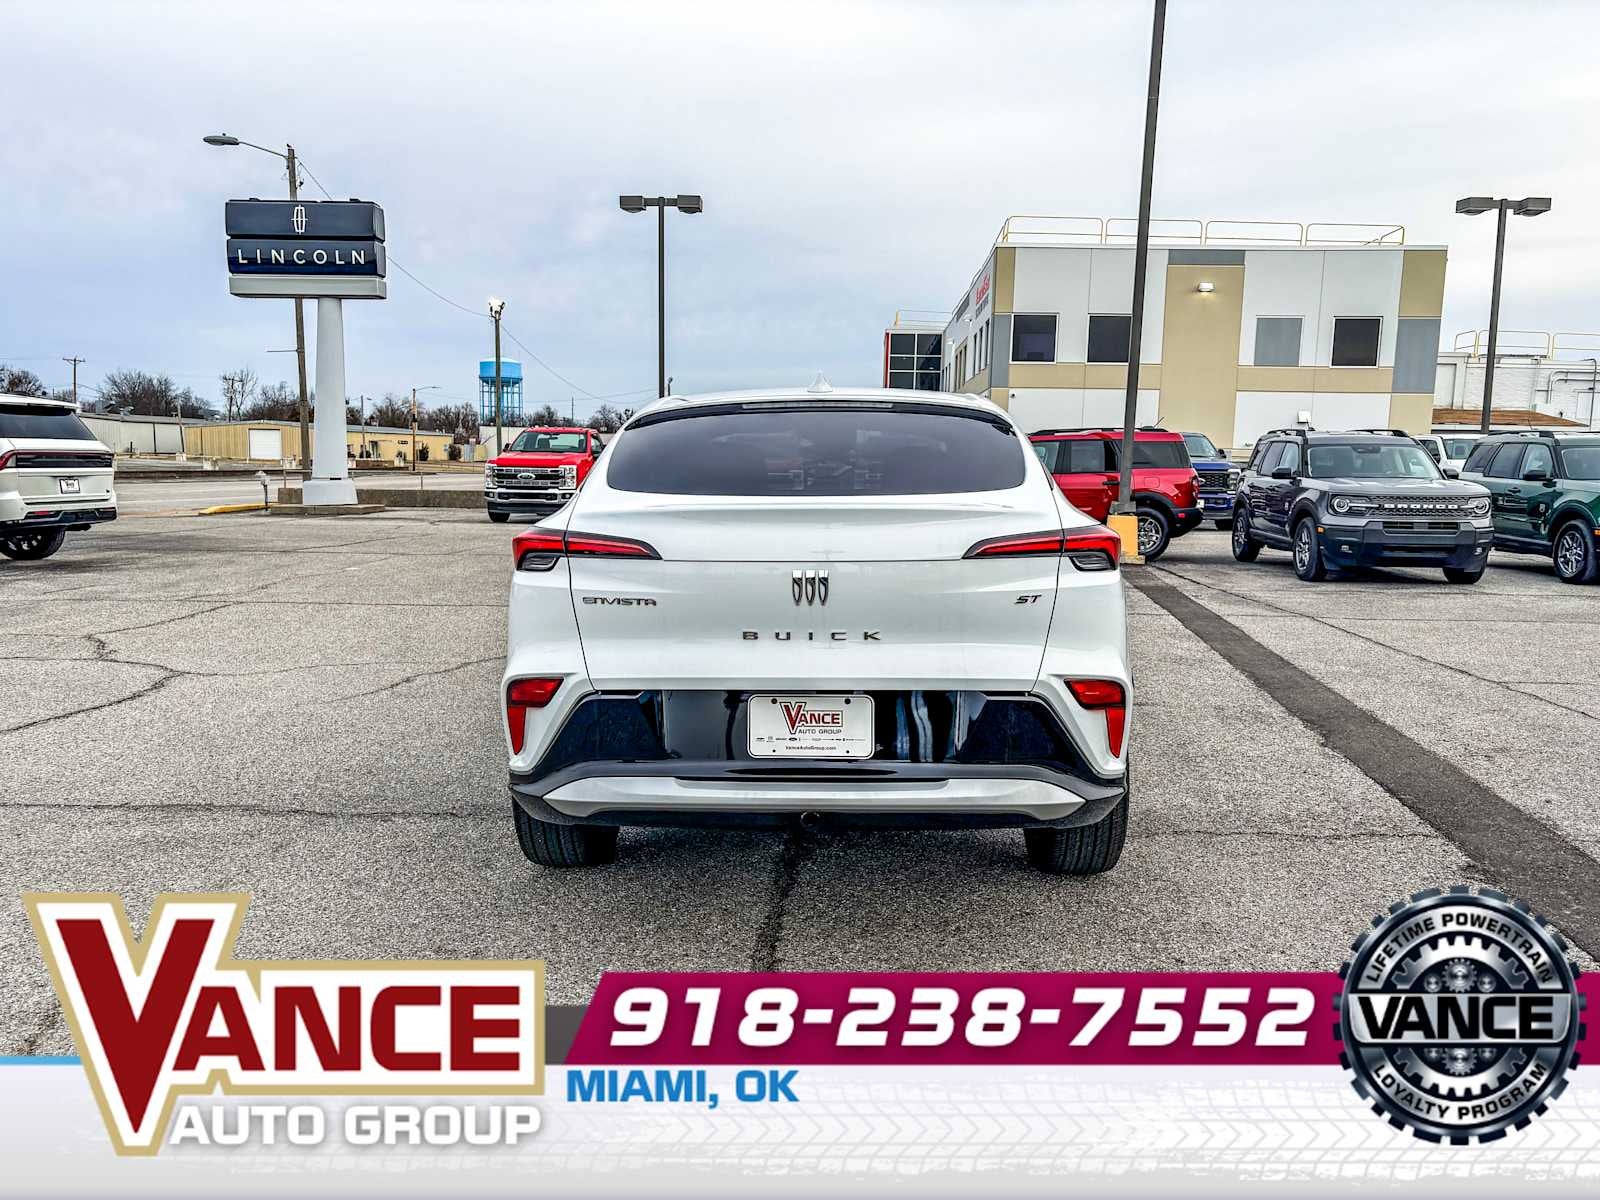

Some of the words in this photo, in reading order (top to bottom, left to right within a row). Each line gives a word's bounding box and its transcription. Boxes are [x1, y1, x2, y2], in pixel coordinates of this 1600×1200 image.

[237, 248, 365, 265] LINCOLN
[582, 597, 657, 606] ENVISTA
[1014, 594, 1042, 604] ST
[742, 631, 881, 641] BUICK
[782, 703, 841, 732] VANCE
